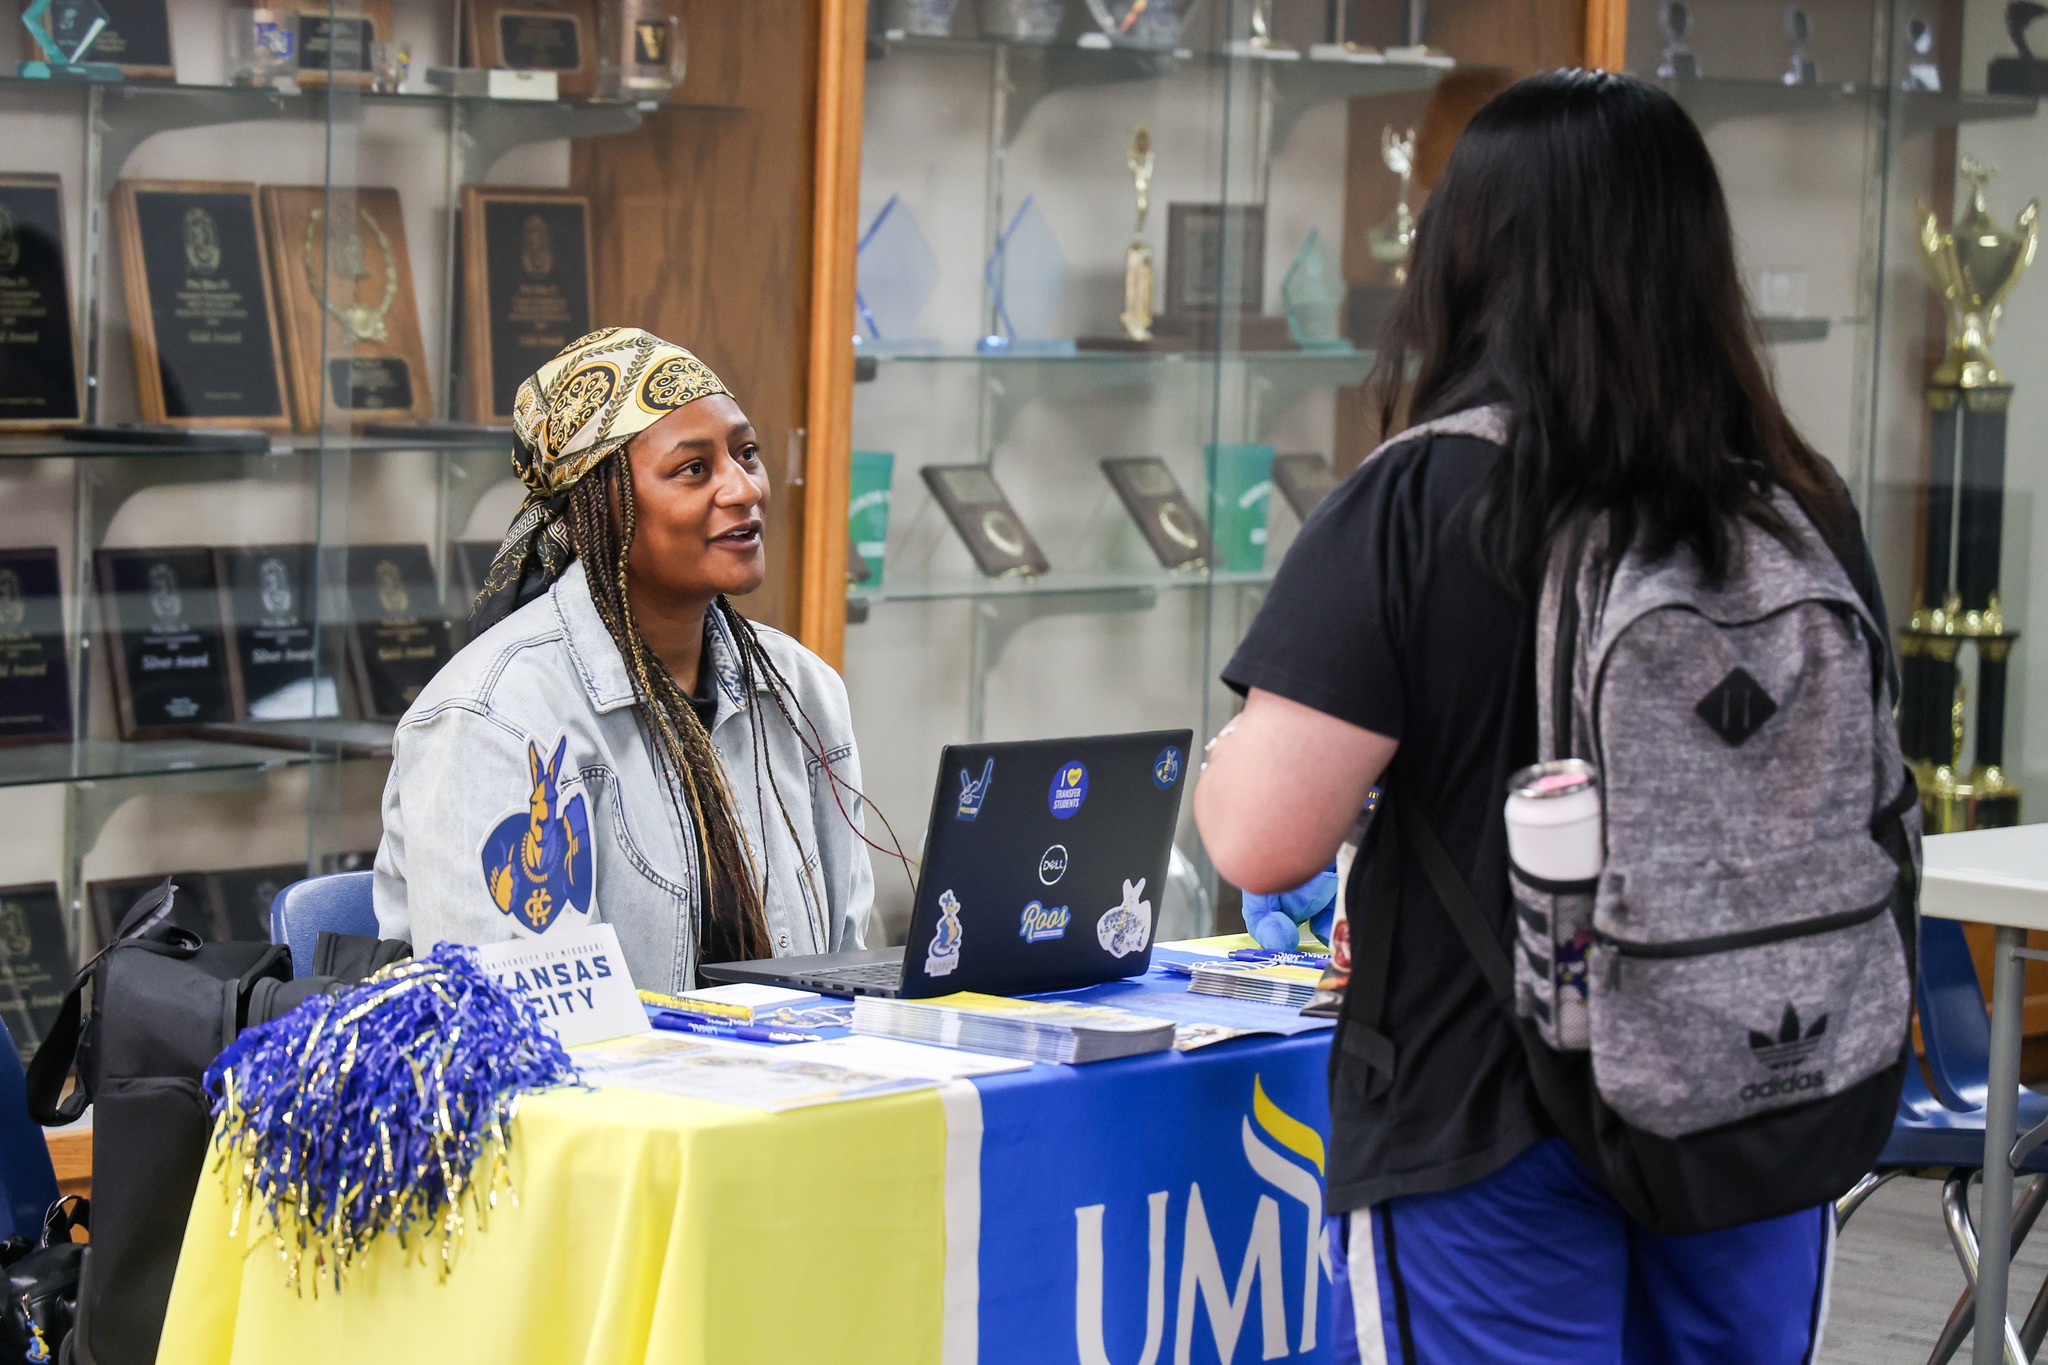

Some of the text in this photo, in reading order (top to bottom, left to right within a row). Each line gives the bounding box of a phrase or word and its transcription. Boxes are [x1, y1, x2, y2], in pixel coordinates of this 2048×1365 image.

[141, 652, 209, 671] Silver Award
[1060, 769, 1067, 788] I
[1053, 798, 1080, 810] STUDENTS
[1042, 859, 1064, 871] DELL
[1022, 903, 1069, 940] Roos
[561, 942, 605, 957] MISSOURI
[497, 955, 612, 992] ANSAS
[1739, 1070, 1825, 1102] adidas
